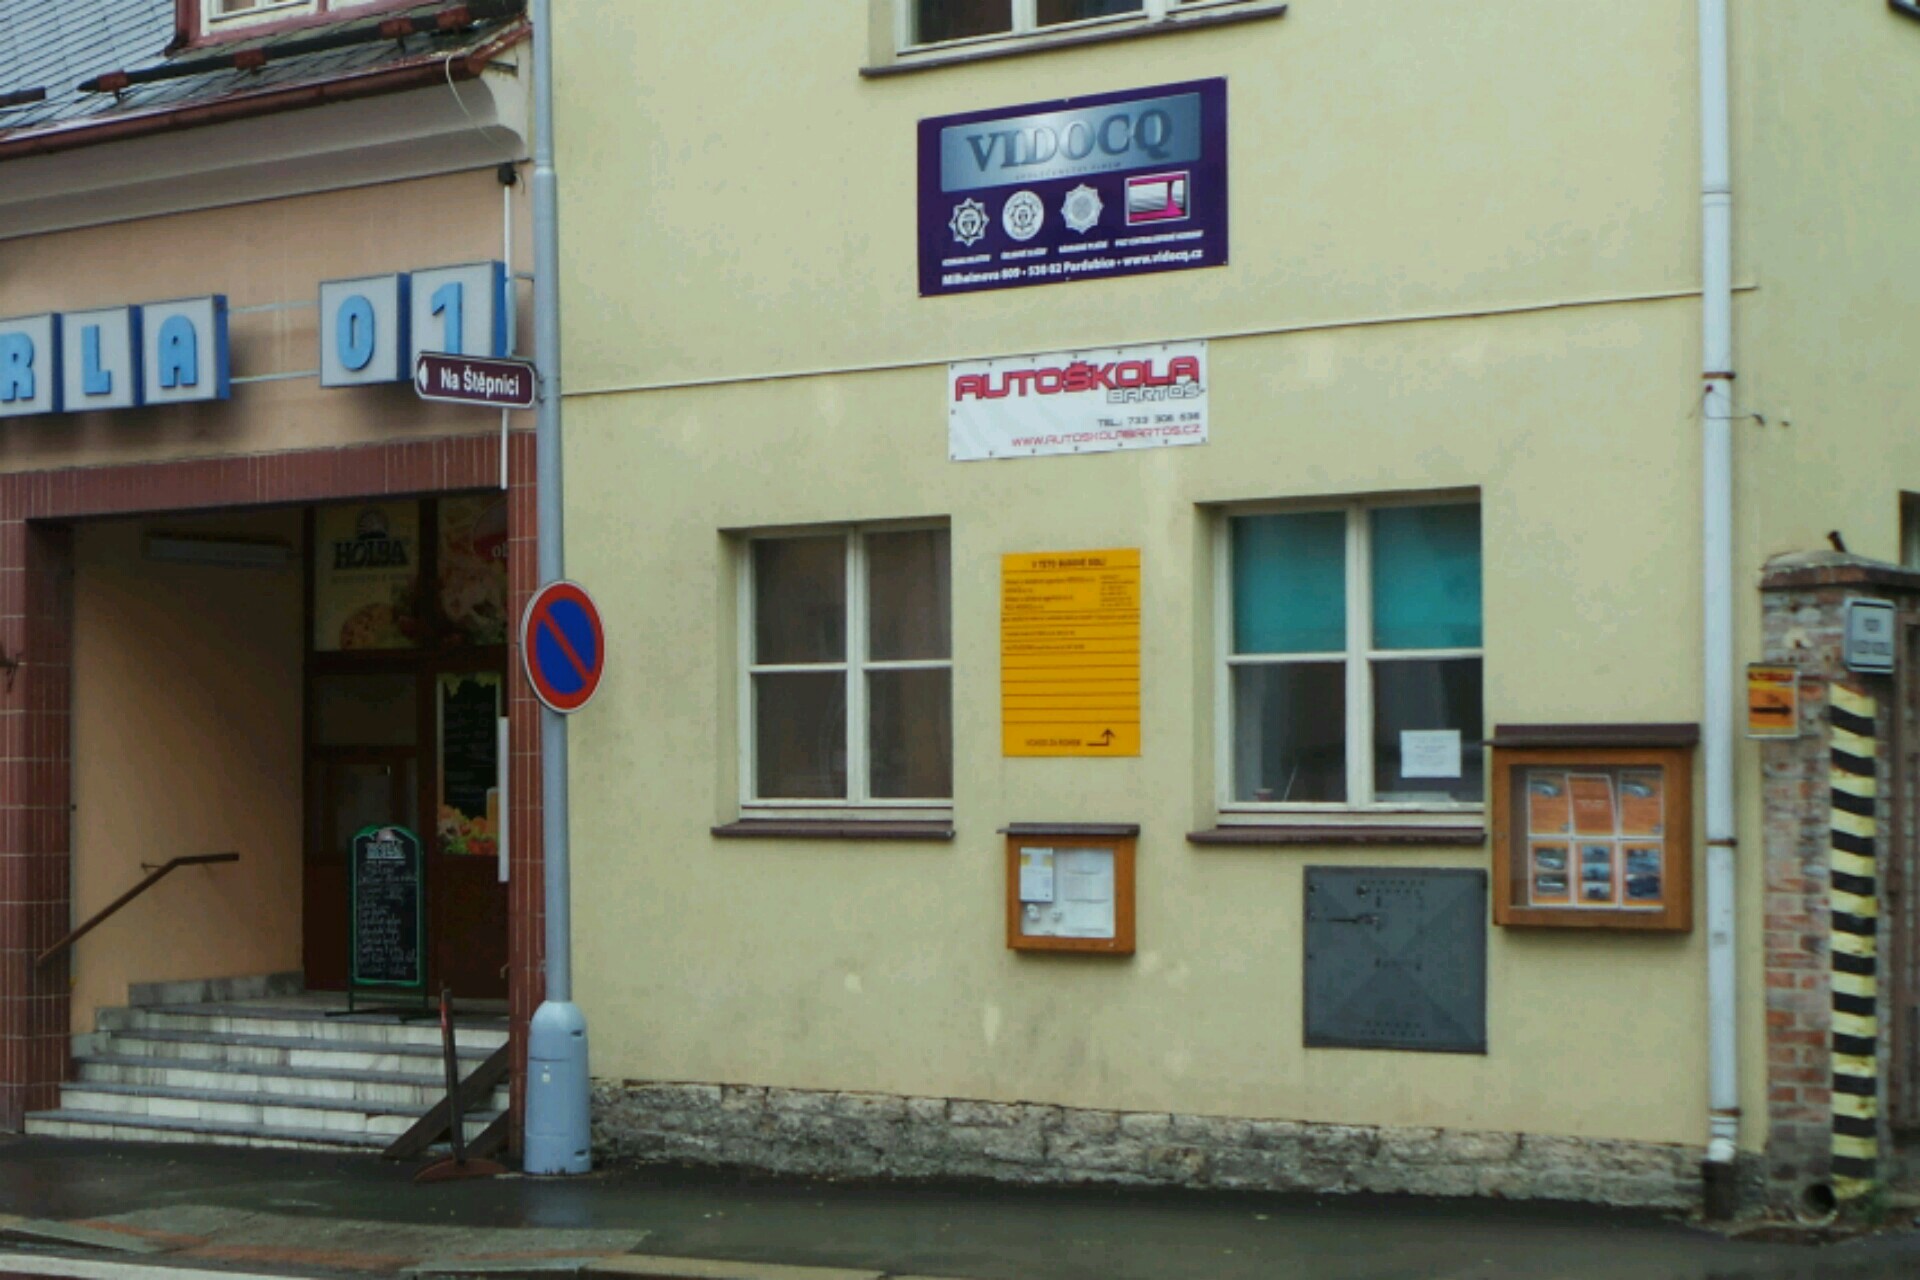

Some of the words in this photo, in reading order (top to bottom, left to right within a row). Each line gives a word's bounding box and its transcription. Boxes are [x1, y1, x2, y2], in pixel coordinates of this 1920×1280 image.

[966, 108, 1172, 172] VIDOCQ
[1123, 249, 1203, 267] www.vidocq.cz
[440, 367, 460, 391] Na
[463, 365, 520, 397] Štěpnici
[955, 355, 1199, 402] AUTOŠKOLA
